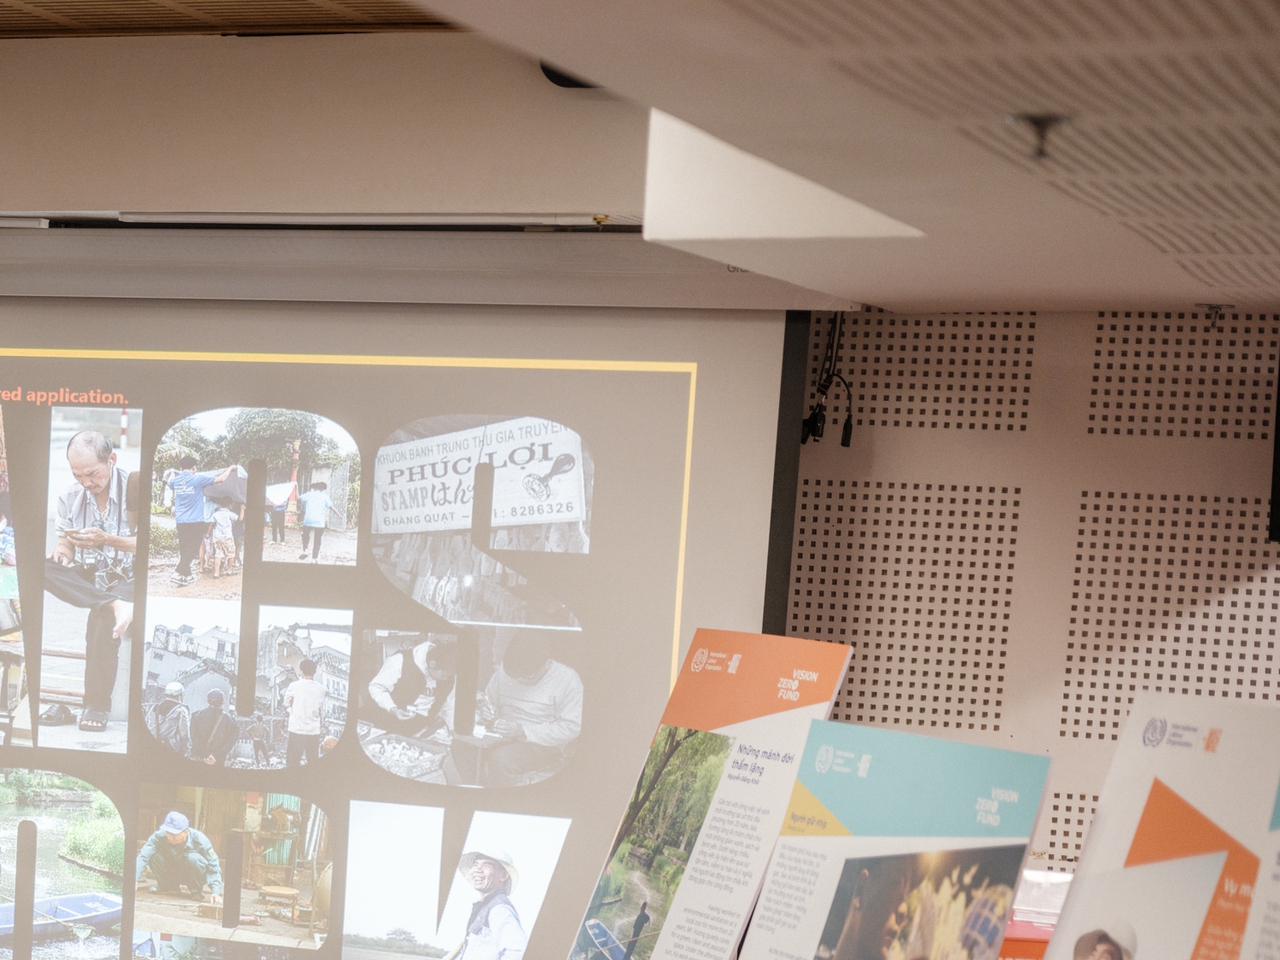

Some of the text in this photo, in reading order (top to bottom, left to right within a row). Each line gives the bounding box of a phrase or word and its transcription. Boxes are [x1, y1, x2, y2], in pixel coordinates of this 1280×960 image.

[26, 388, 129, 406] application.
[436, 438, 470, 454] TRUNG
[472, 433, 492, 448] THU
[496, 430, 515, 444] GIA
[387, 442, 554, 486] PHÚC LỢI
[381, 486, 429, 512] STAMP
[424, 511, 455, 524] QUẠT
[510, 501, 574, 517] 8286326
[777, 677, 799, 690] ZERO
[792, 669, 819, 682] VISION
[778, 688, 800, 702] FUND
[736, 743, 761, 760] Những
[991, 787, 1019, 803] VISION
[976, 811, 1001, 826] FUND
